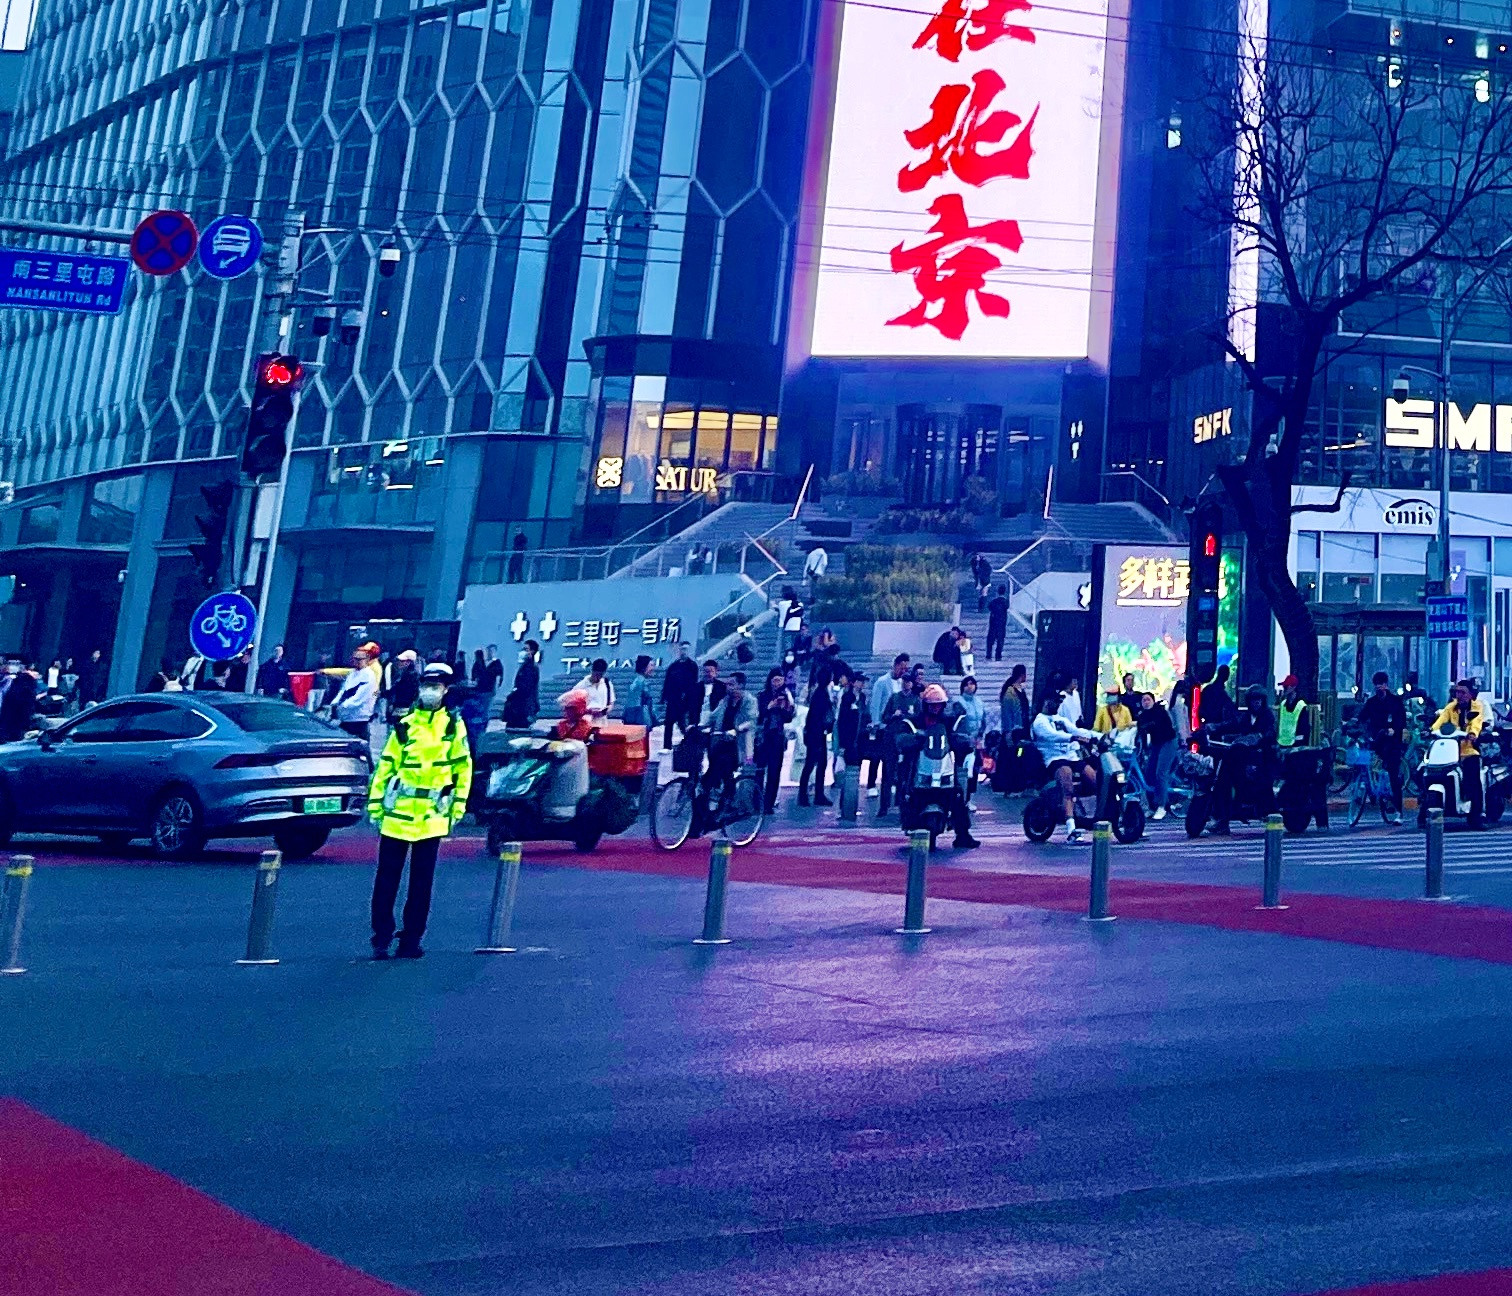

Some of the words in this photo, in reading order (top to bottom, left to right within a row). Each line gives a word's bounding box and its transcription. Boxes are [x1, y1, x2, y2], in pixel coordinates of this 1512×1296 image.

[12, 259, 115, 286] 南三里屯路
[1193, 407, 1232, 444] SMFK
[562, 618, 680, 647] 三里屯一号场
